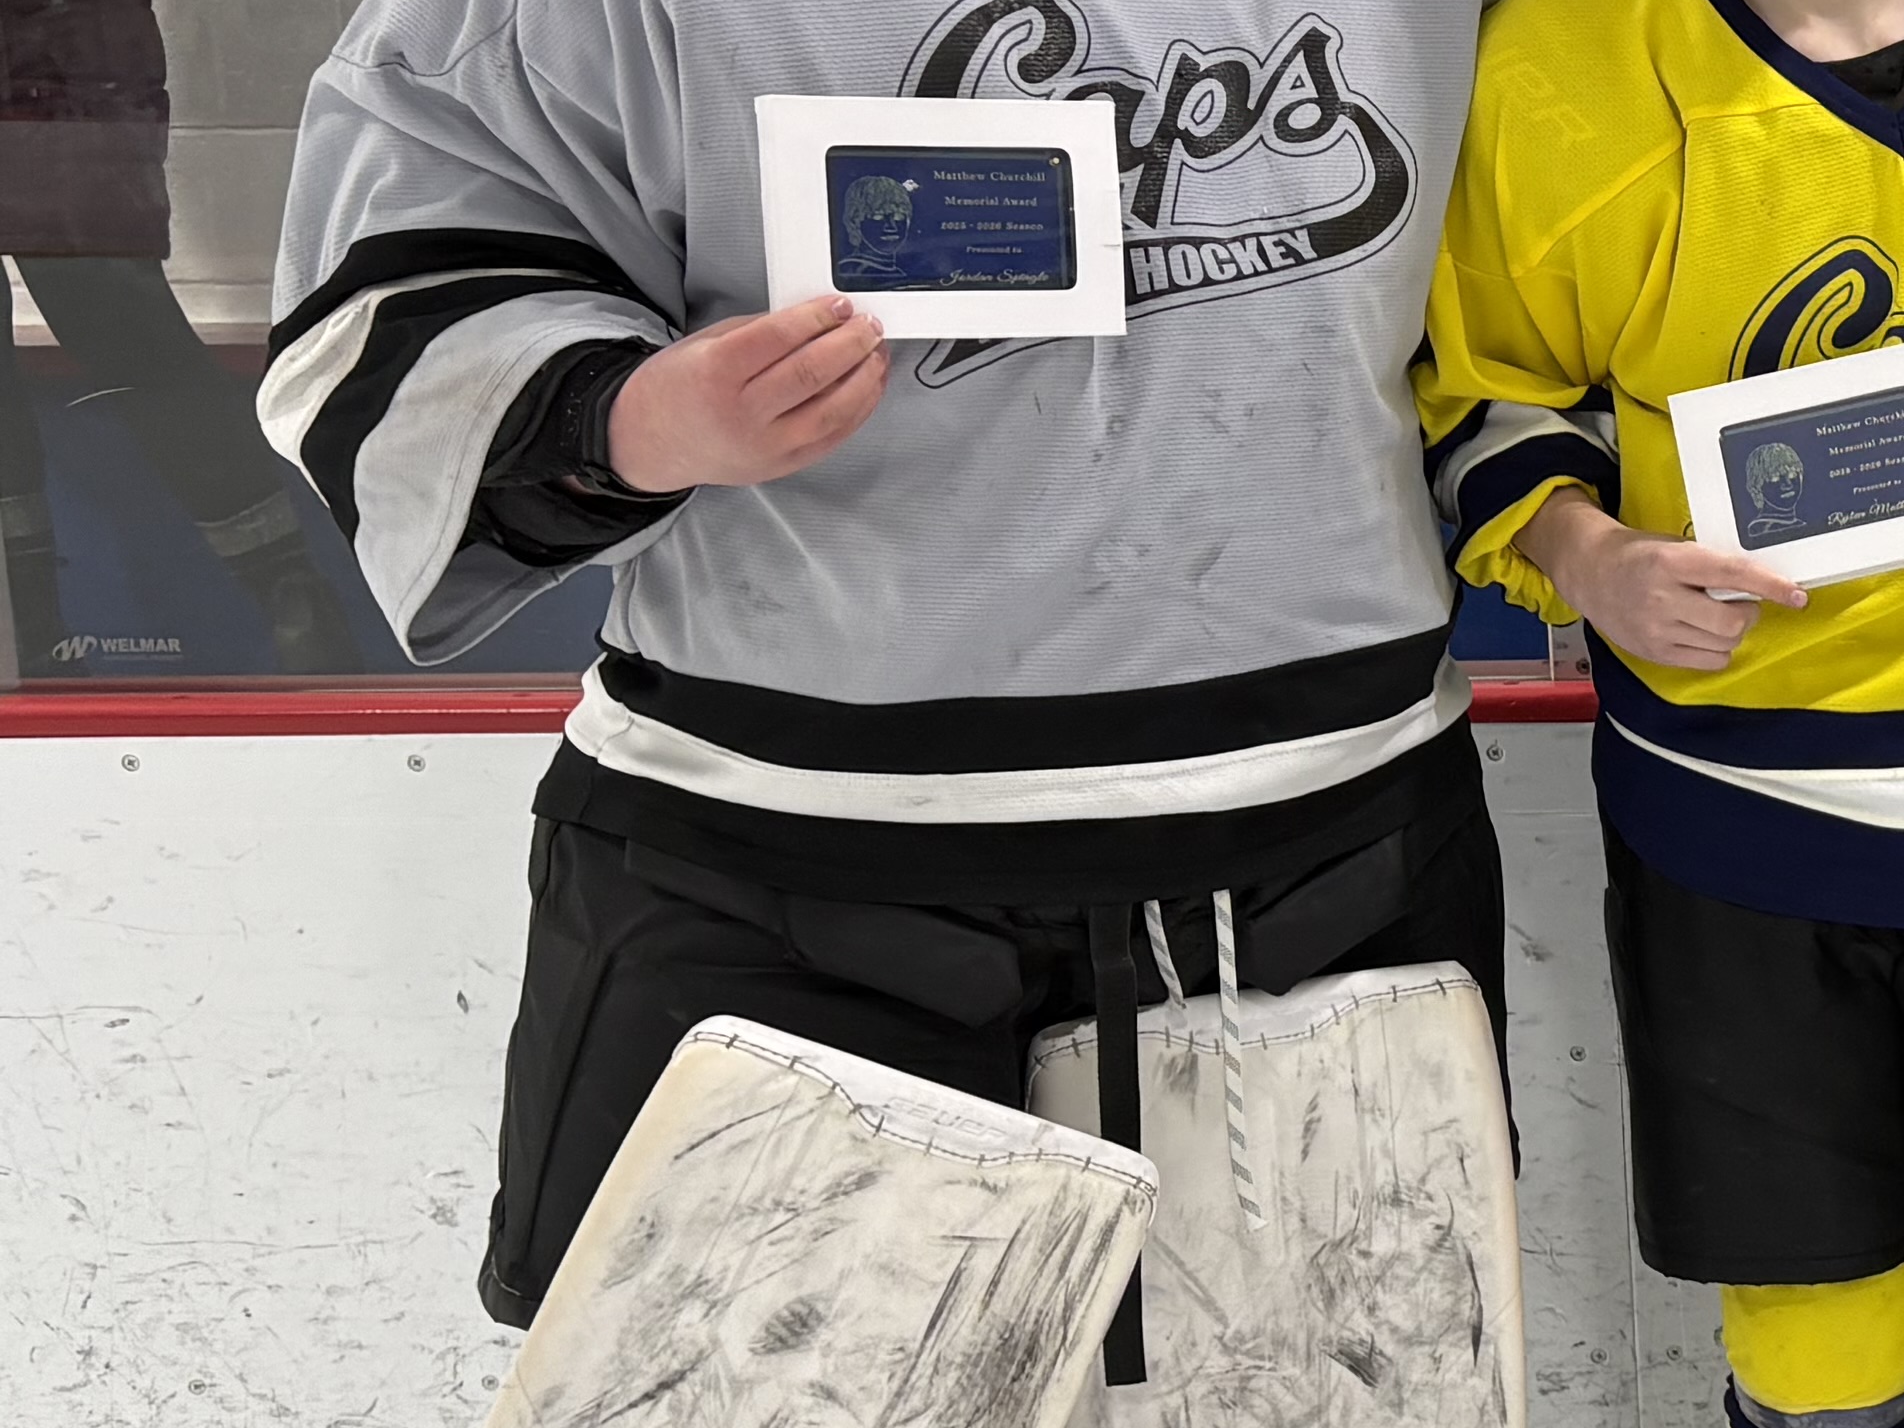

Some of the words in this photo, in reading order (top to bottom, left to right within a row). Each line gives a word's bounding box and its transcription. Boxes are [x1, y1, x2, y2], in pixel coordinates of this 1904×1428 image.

[944, 196, 999, 206] Memorial
[1002, 197, 1038, 207] Award
[1130, 228, 1318, 296] HOCKEY
